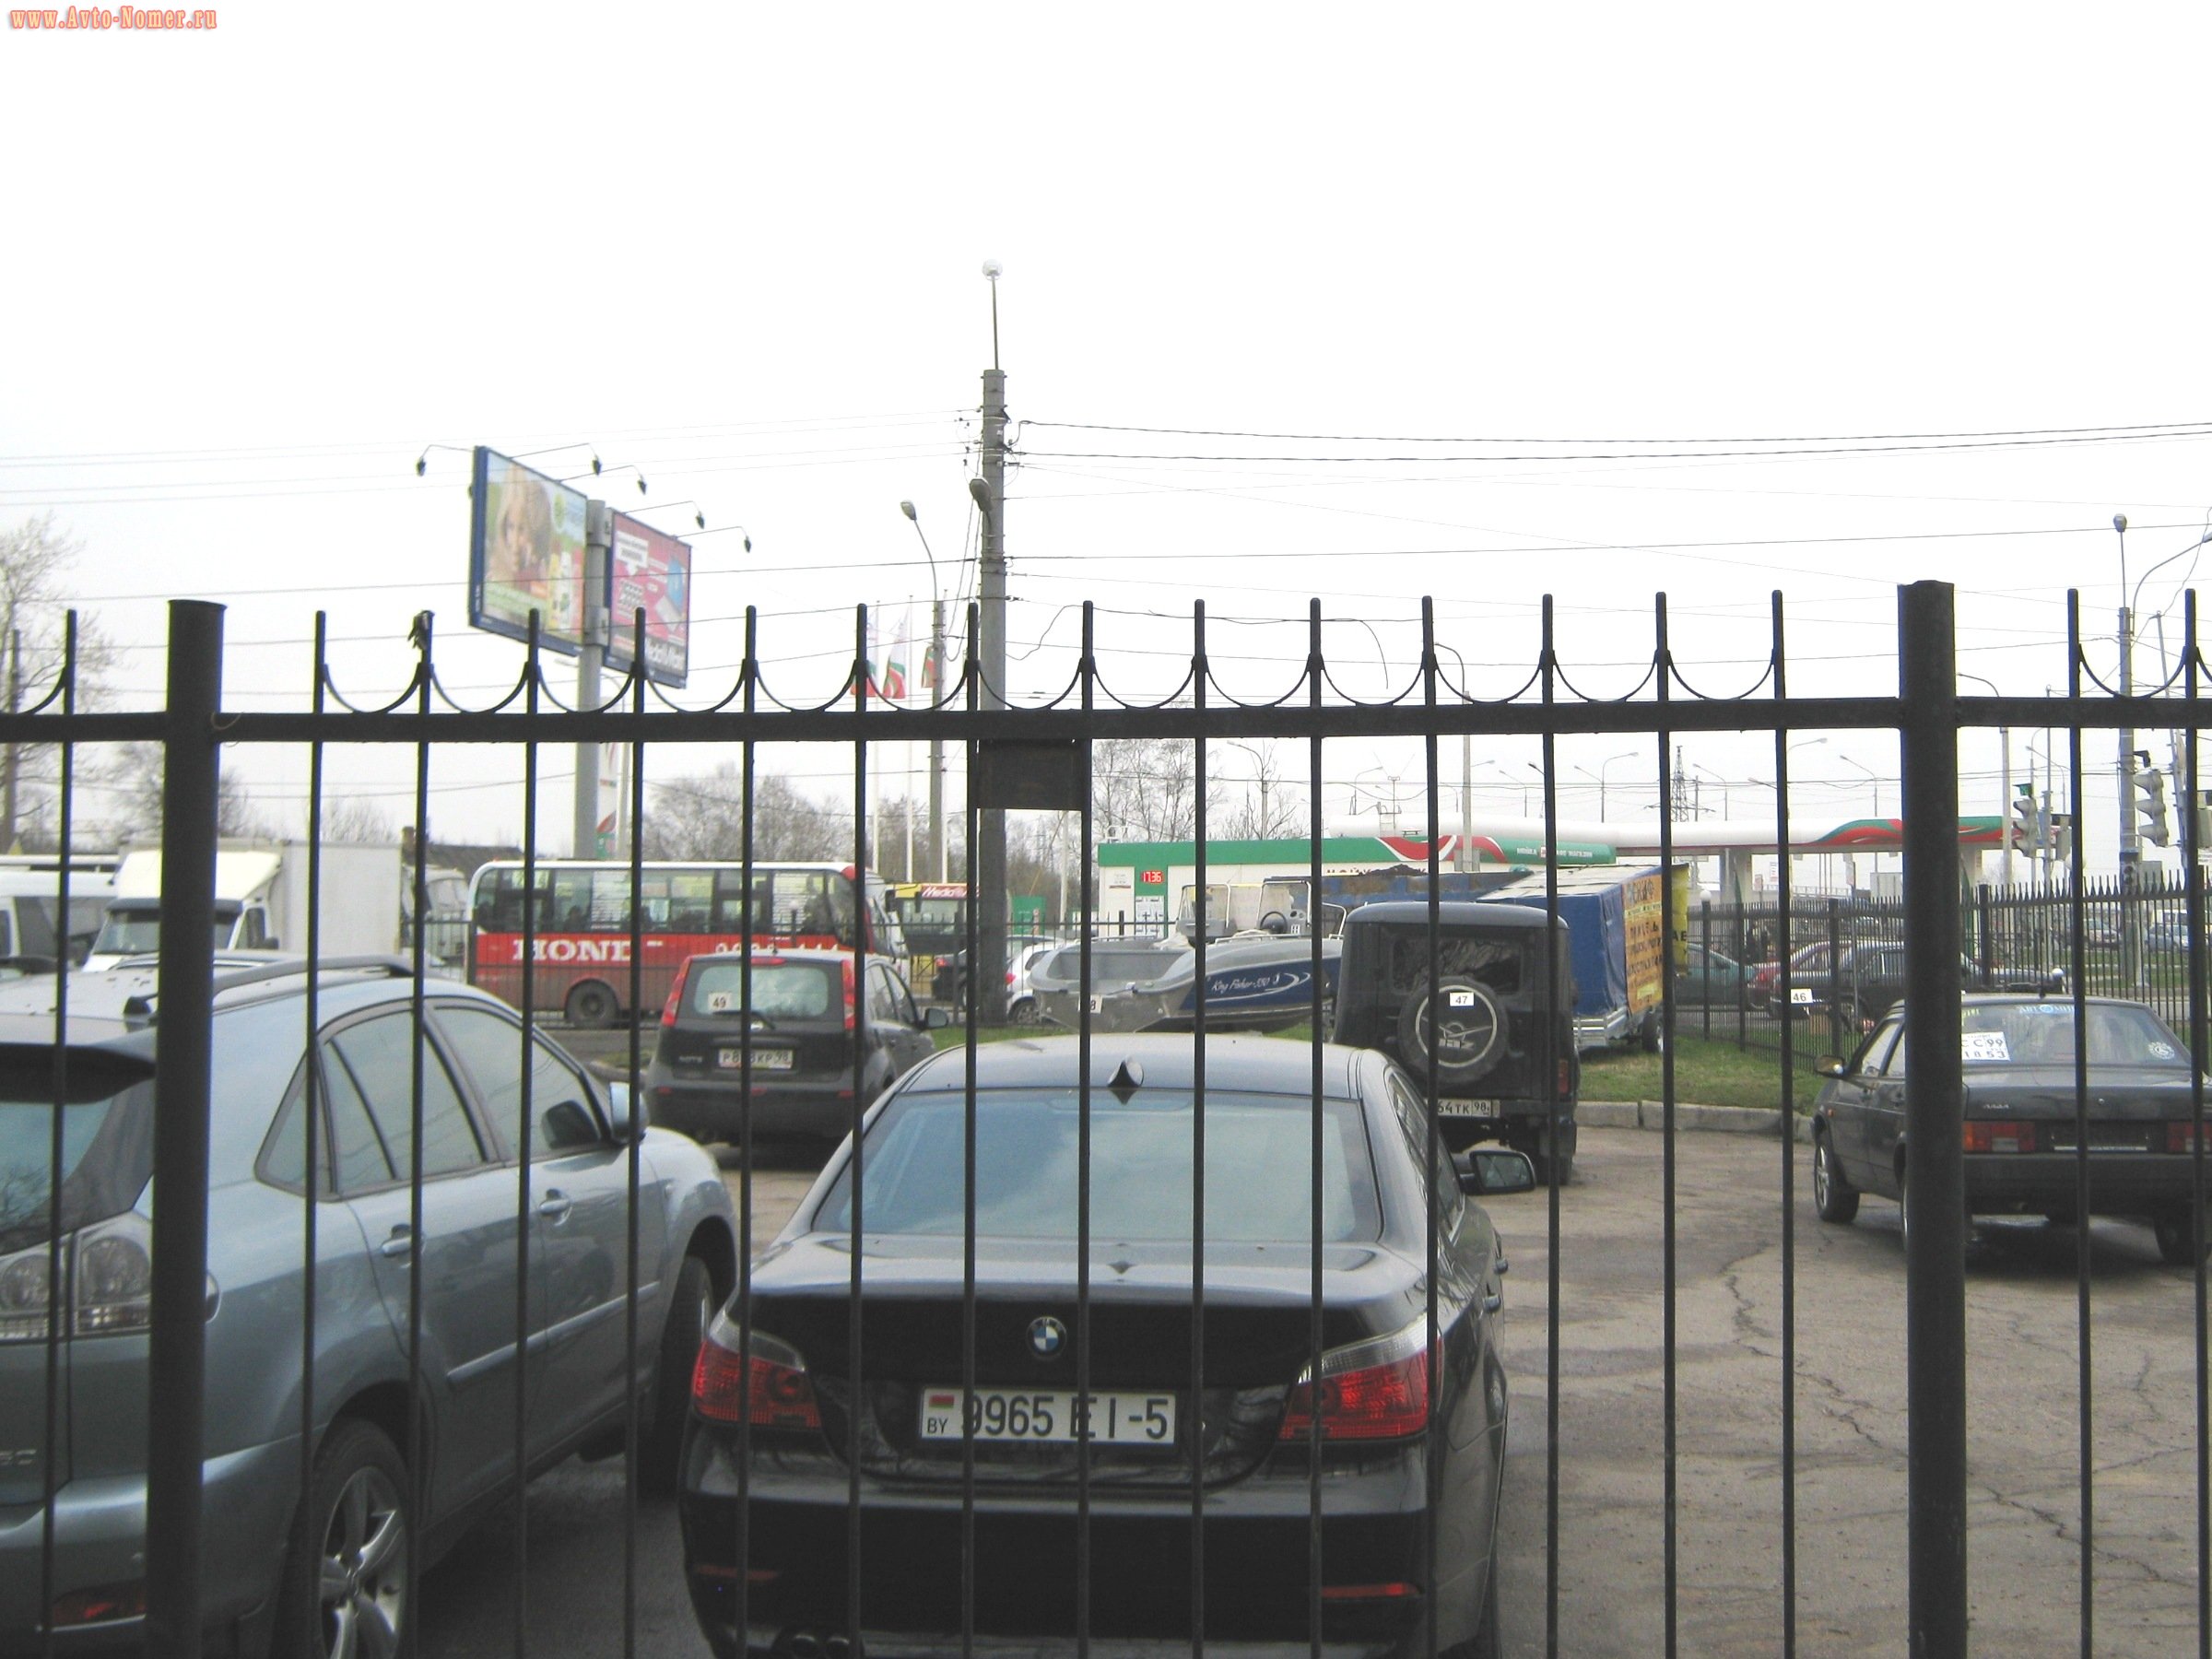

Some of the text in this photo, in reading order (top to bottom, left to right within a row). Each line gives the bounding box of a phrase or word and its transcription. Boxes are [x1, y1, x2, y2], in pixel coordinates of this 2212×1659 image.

[1455, 995, 1468, 1005] 47
[1793, 992, 1807, 1002] 46
[712, 997, 727, 1008] 49
[927, 1418, 947, 1434] BY
